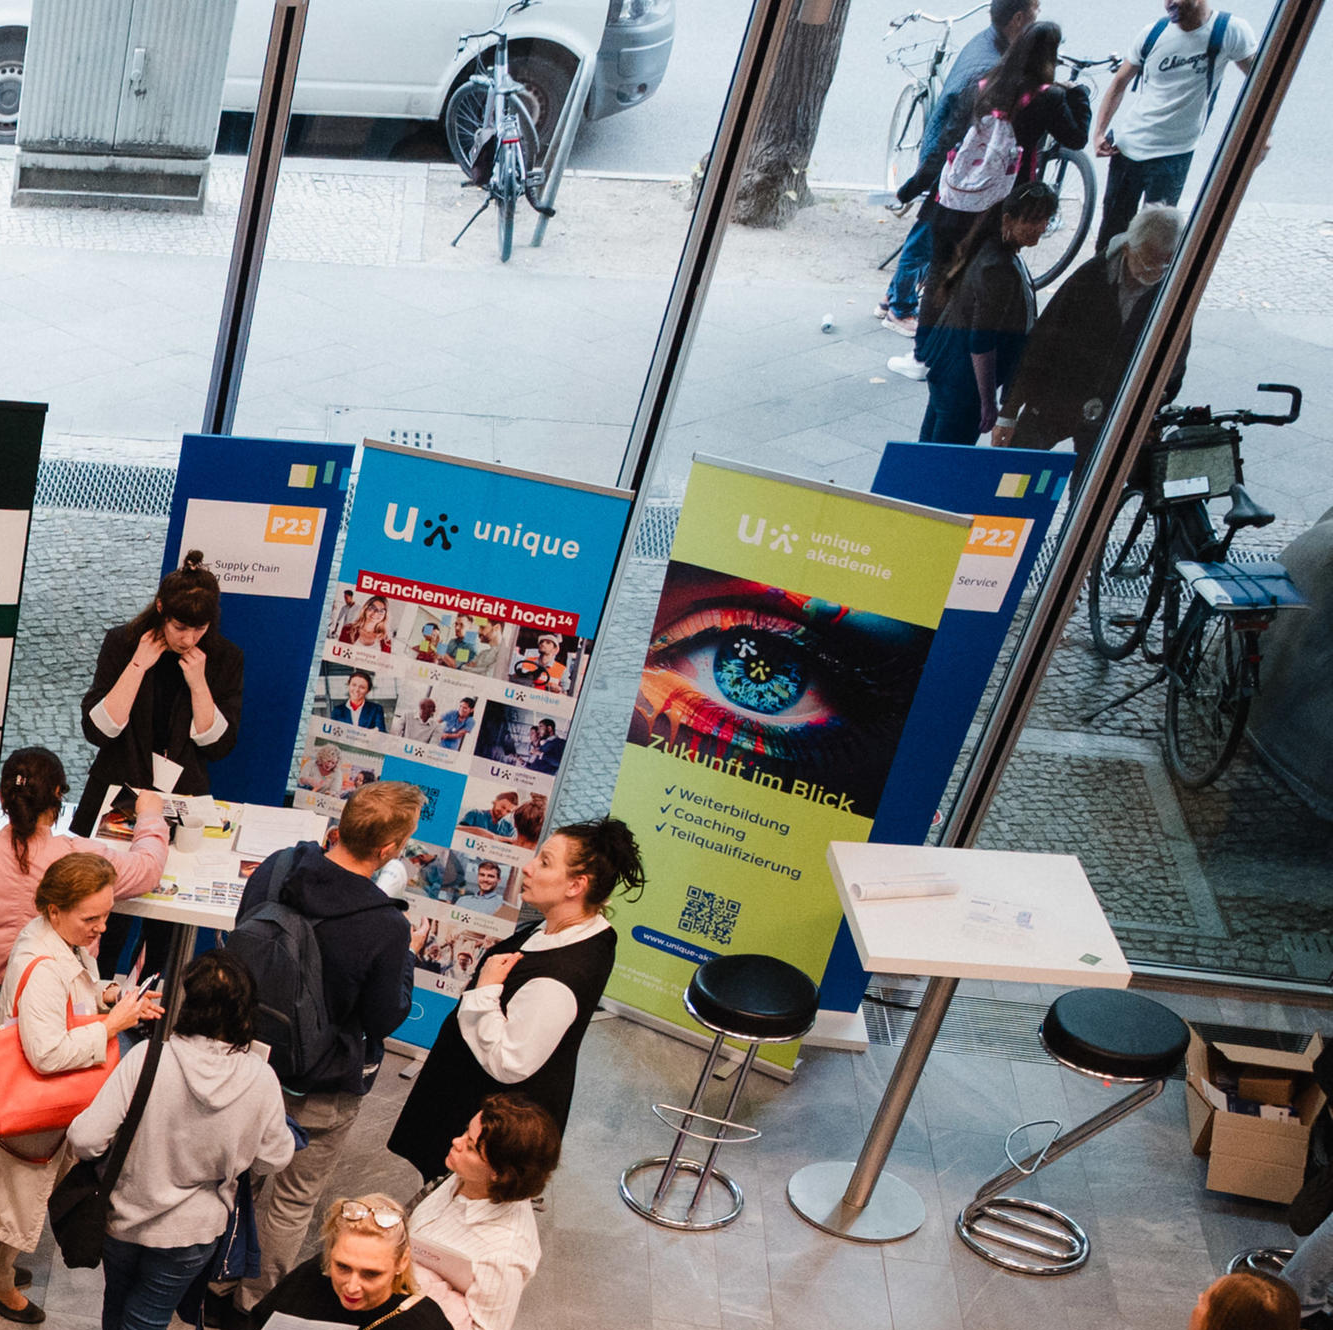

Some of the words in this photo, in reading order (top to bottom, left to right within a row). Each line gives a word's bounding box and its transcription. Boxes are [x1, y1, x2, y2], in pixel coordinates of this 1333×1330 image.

[271, 517, 311, 536] P23
[473, 519, 580, 559] unique
[811, 530, 872, 556] unique
[968, 527, 1015, 548] P22
[215, 560, 249, 572] Supply
[252, 563, 280, 573] Chain
[224, 573, 254, 583] GmbH
[805, 547, 893, 582] akademie
[360, 575, 508, 618] Branchenvielfalt
[957, 575, 997, 588] Service
[646, 733, 746, 781] Zukunft
[752, 764, 783, 792] im
[790, 778, 856, 814] Blick
[674, 807, 746, 842] Coaching
[678, 787, 791, 836] Weiterbildung
[670, 825, 802, 881] Teilqualifizierung
[643, 931, 713, 962] www.unique-ak
